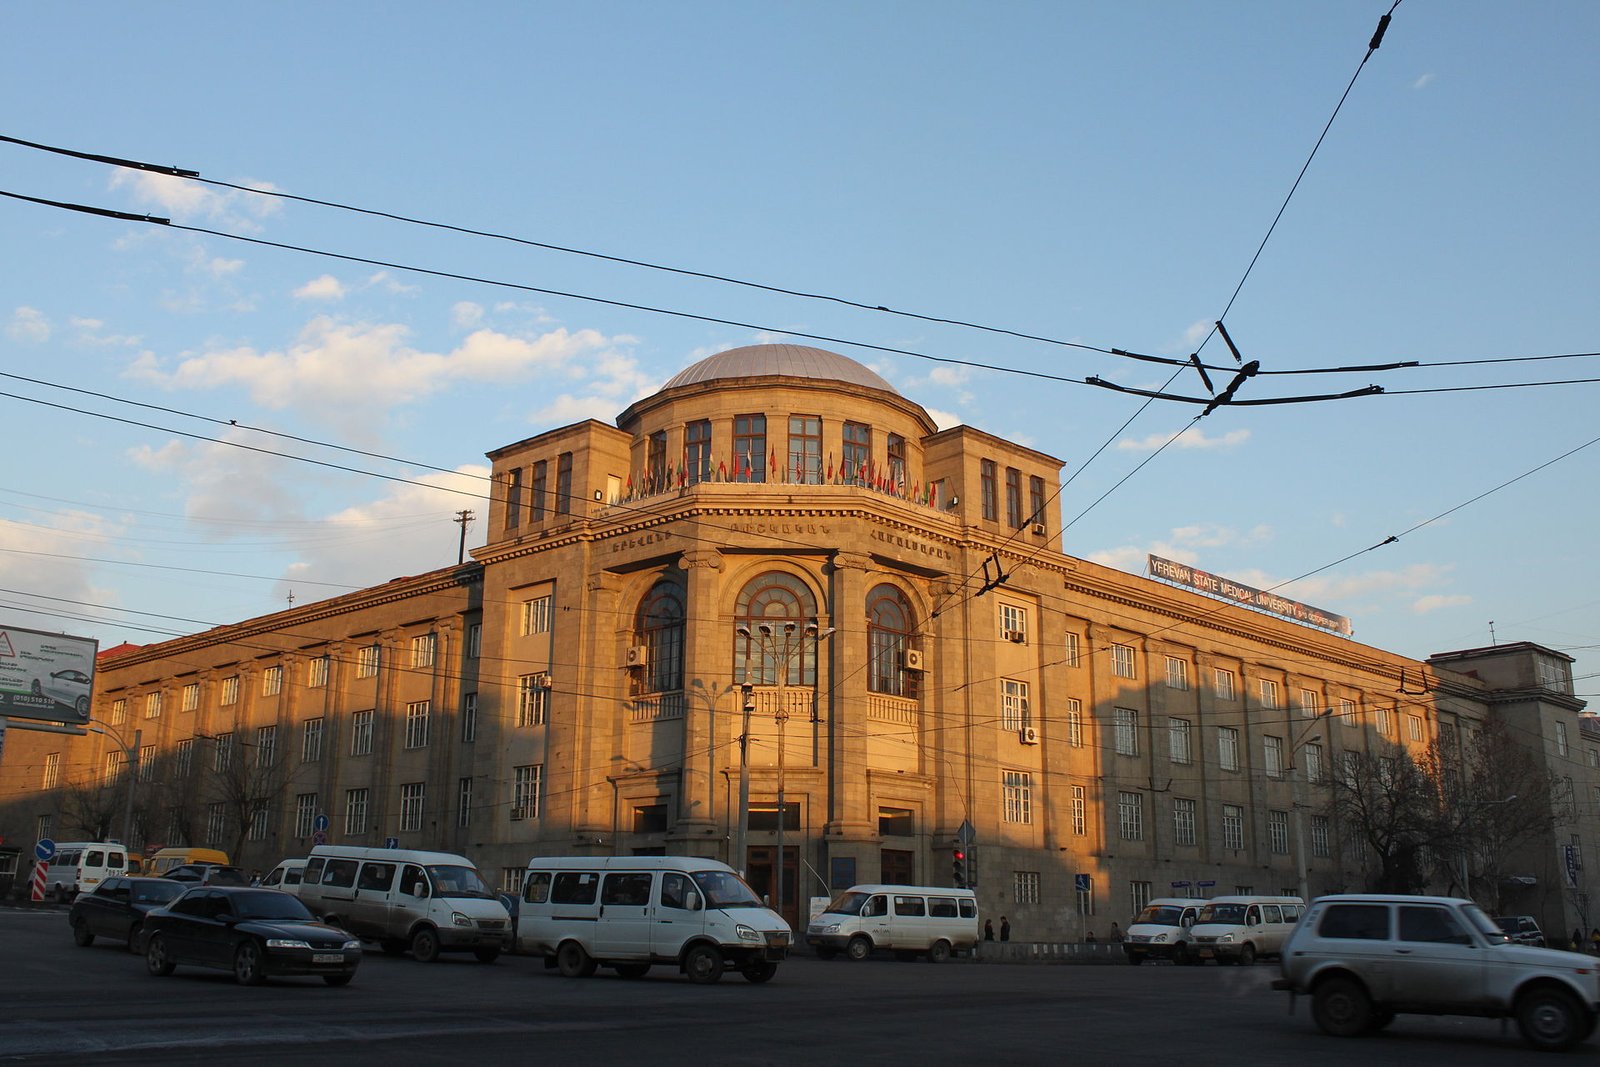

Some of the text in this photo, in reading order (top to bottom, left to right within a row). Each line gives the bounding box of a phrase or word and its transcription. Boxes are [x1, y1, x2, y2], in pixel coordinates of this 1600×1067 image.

[1151, 560, 1191, 583] YEREVAN
[1193, 573, 1218, 591] STATE
[1220, 582, 1254, 603] MEDICAL
[1255, 594, 1298, 616] UNIVERSITY
